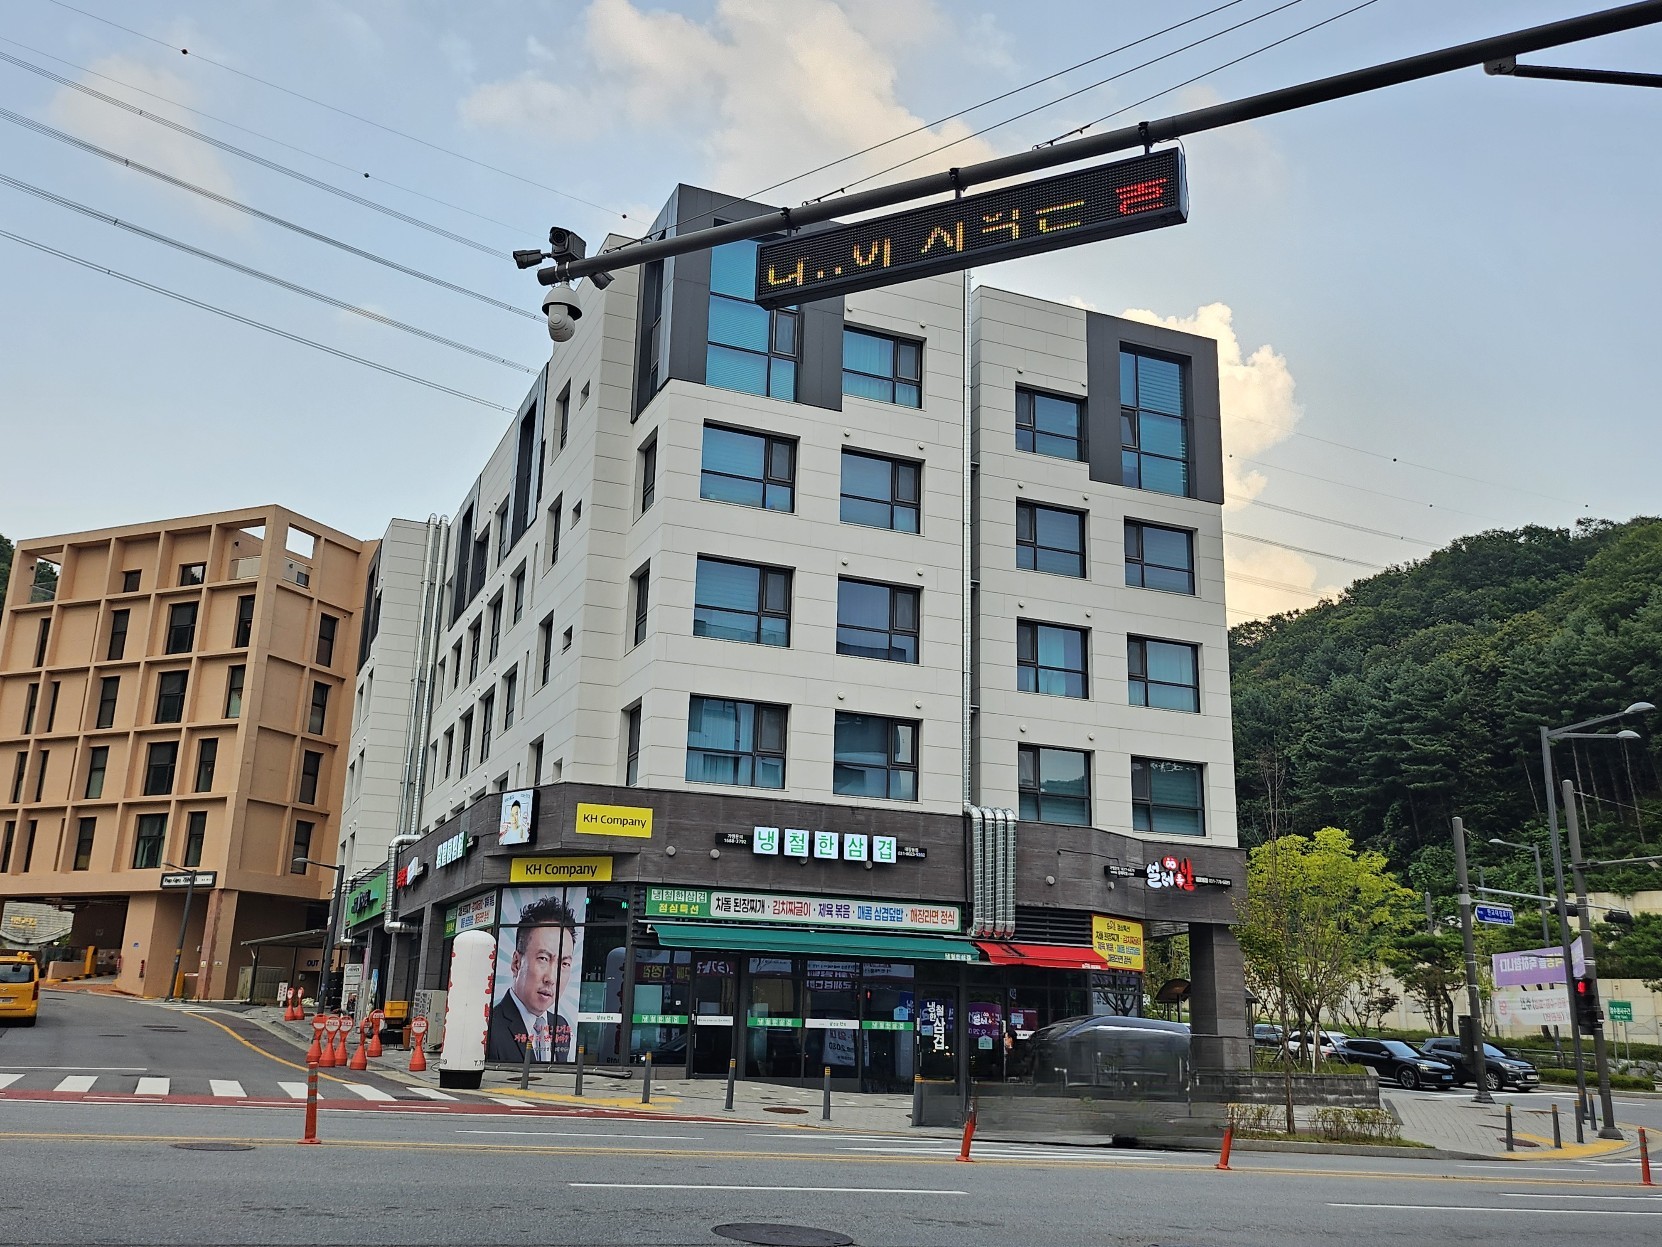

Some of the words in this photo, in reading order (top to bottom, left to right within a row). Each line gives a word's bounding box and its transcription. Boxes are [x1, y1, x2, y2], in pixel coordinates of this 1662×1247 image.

[583, 814, 598, 824] KH
[600, 814, 647, 829] Company
[756, 830, 895, 862] 냉철한삼겹
[525, 864, 542, 875] KH
[544, 863, 598, 878] Company
[658, 903, 699, 915] 점심특선
[715, 896, 732, 912] 차돌
[733, 897, 766, 914] 된장찌개
[772, 900, 811, 918] 김치짜글이
[818, 902, 834, 918] 제육
[835, 903, 851, 919] 볶음
[857, 905, 872, 921] 매콤
[874, 906, 904, 922] 삼겹덮밥
[940, 910, 955, 924] 정식
[306, 959, 320, 967] OUT
